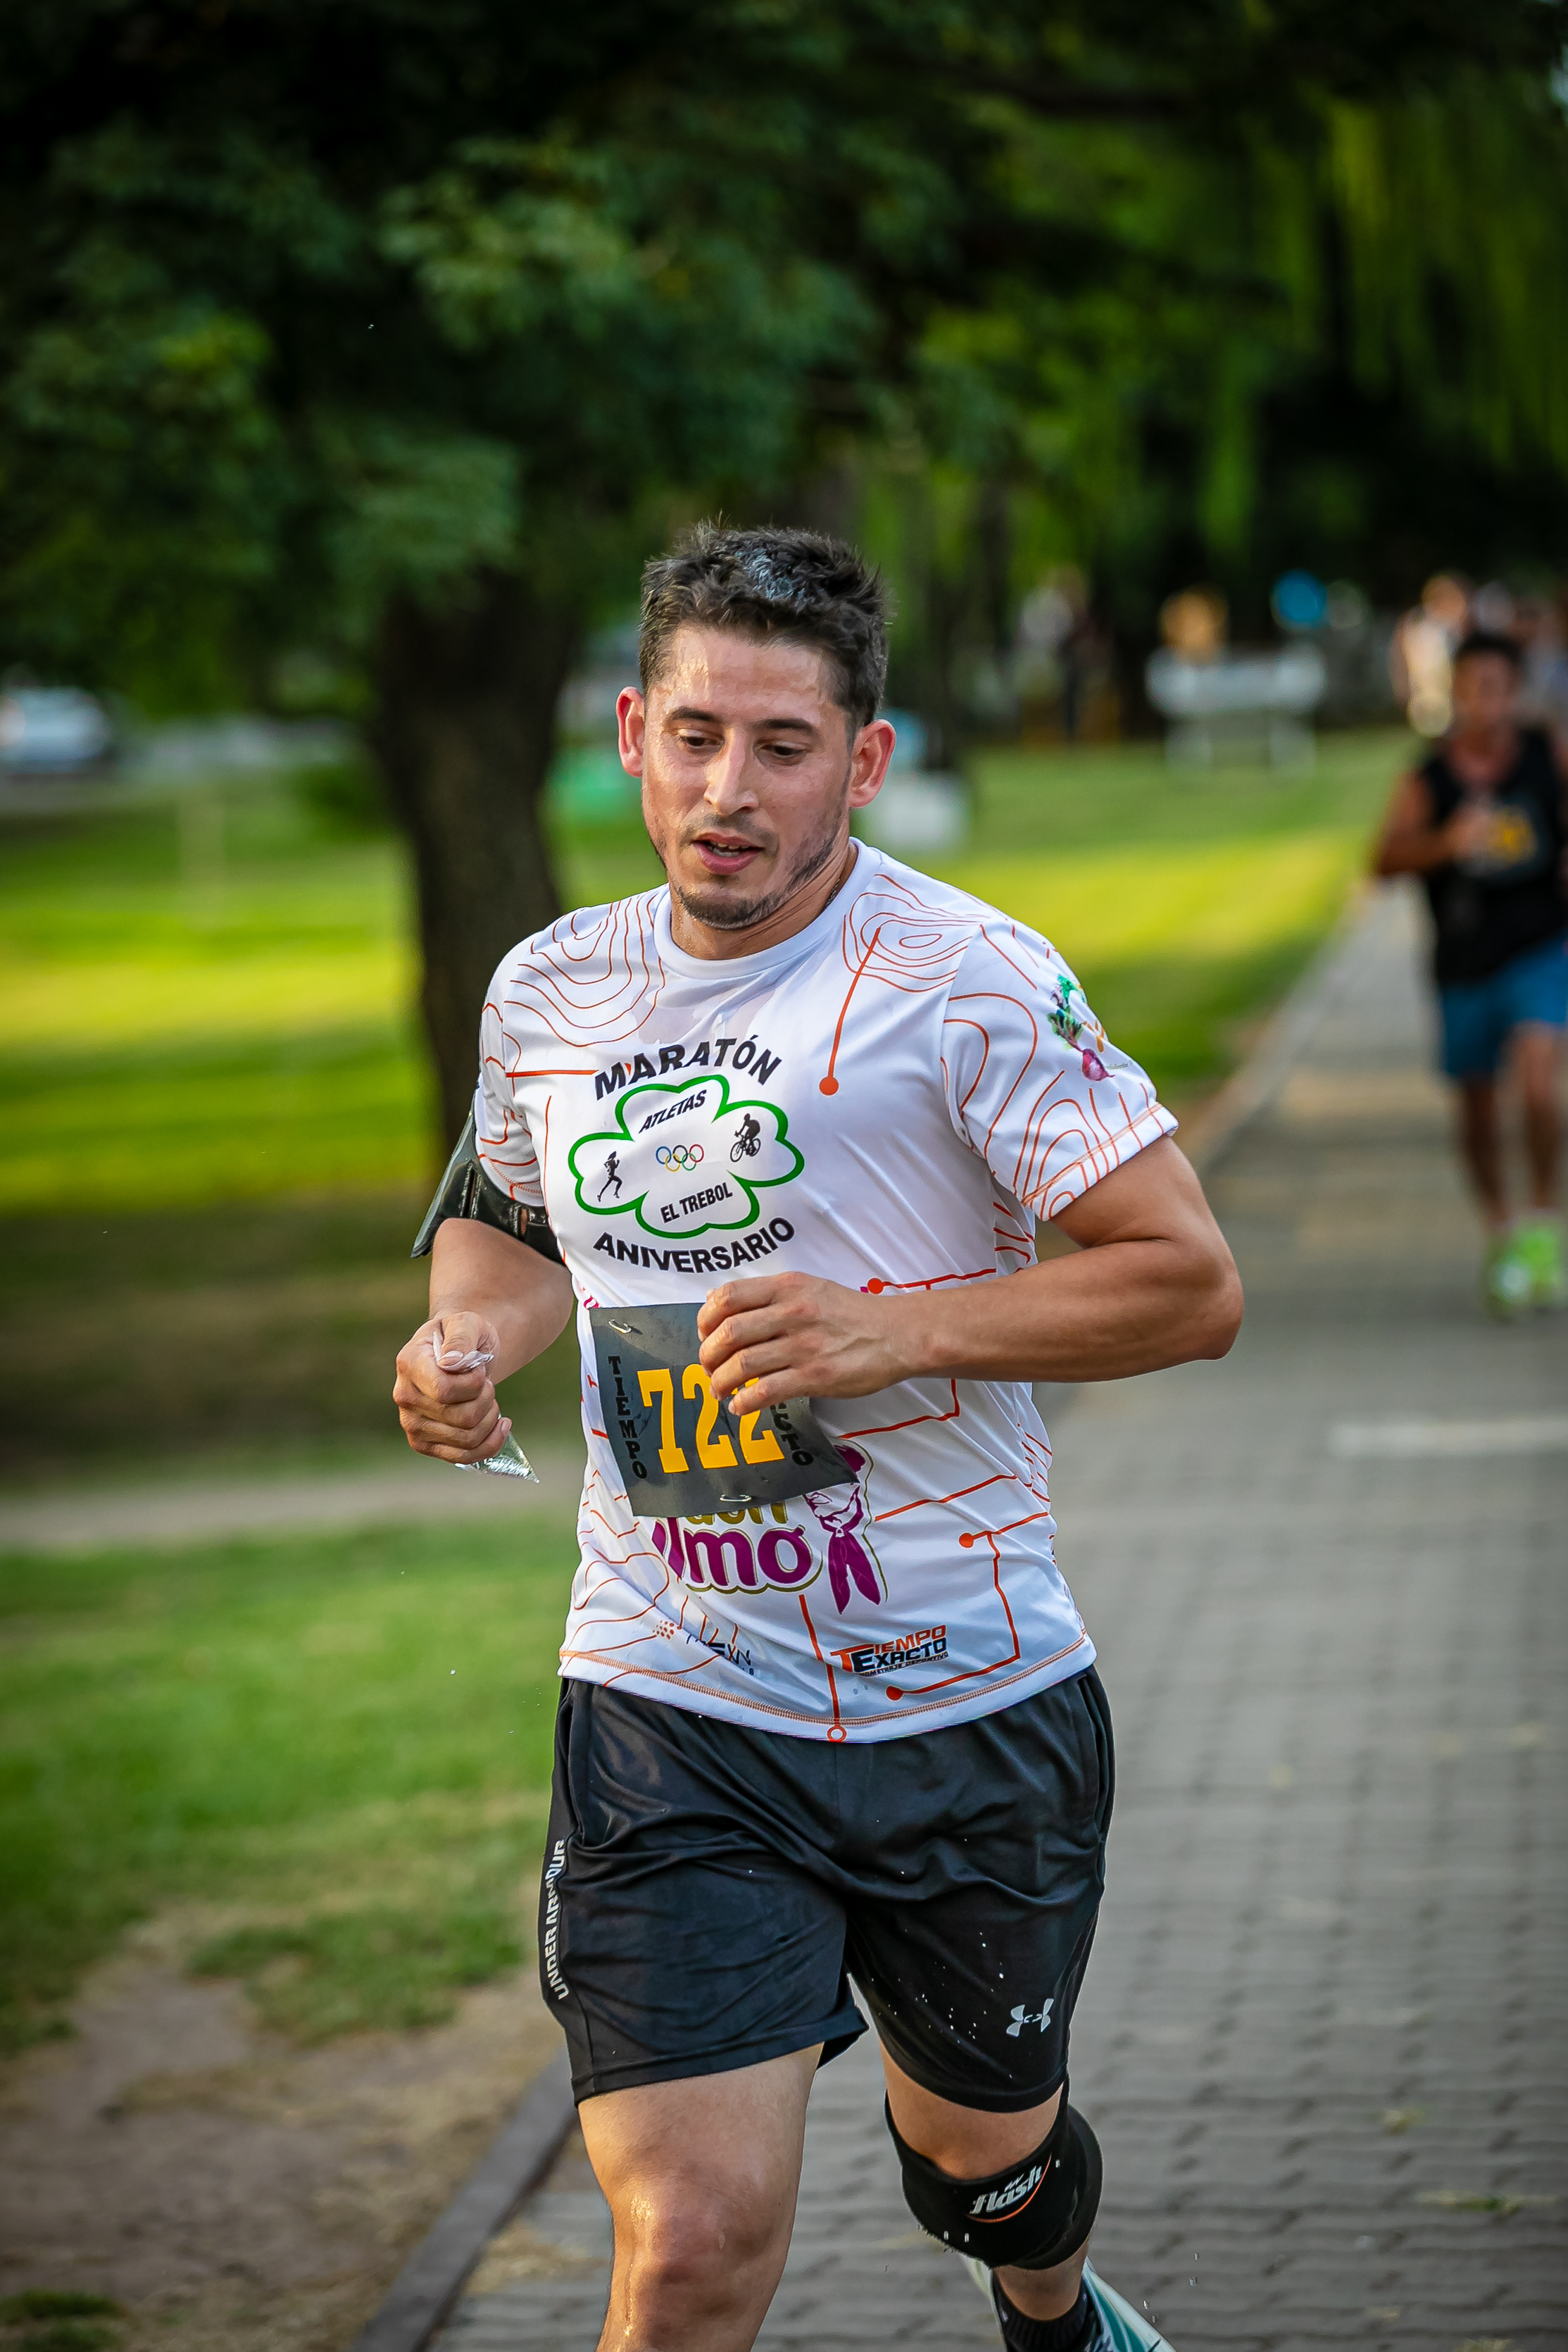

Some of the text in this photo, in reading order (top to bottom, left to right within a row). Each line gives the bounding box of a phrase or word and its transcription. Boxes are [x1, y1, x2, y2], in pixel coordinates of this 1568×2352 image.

[595, 1034, 782, 1101] MARATÓN
[638, 1089, 708, 1134] ATLETAS
[660, 1182, 733, 1224] EL TREBOL
[593, 1217, 795, 1274] ANIVERSARIO
[608, 1356, 648, 1480] TIEMPO
[637, 1363, 785, 1473] 722
[769, 1401, 814, 1466] CTO
[830, 1624, 946, 1672] TIEMPO
[851, 1637, 947, 1673] EXACTO
[544, 1839, 570, 2000] UNDER ARMOUR
